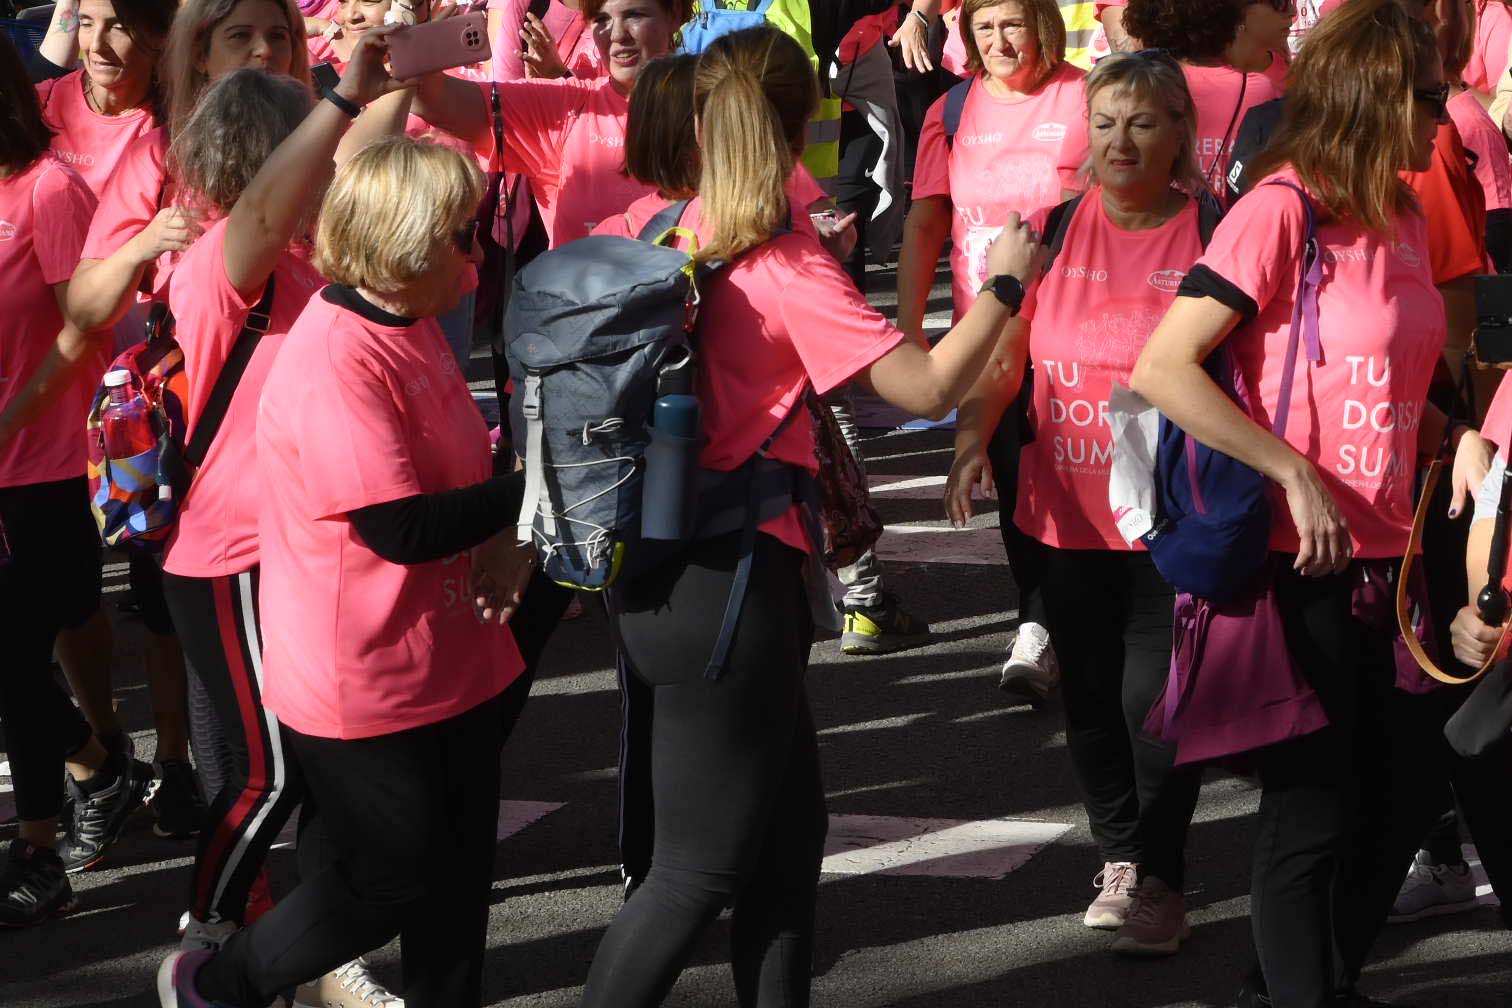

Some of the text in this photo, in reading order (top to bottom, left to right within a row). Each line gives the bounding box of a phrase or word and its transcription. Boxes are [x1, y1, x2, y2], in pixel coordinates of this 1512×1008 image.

[589, 134, 625, 147] OYSH
[52, 149, 95, 166] YSHO
[1043, 359, 1079, 388] TU
[1345, 355, 1391, 388] TU
[1050, 399, 1111, 427] DOR
[1342, 398, 1421, 433] DORSA
[1054, 435, 1116, 465] SUM
[1336, 443, 1409, 478] SUM
